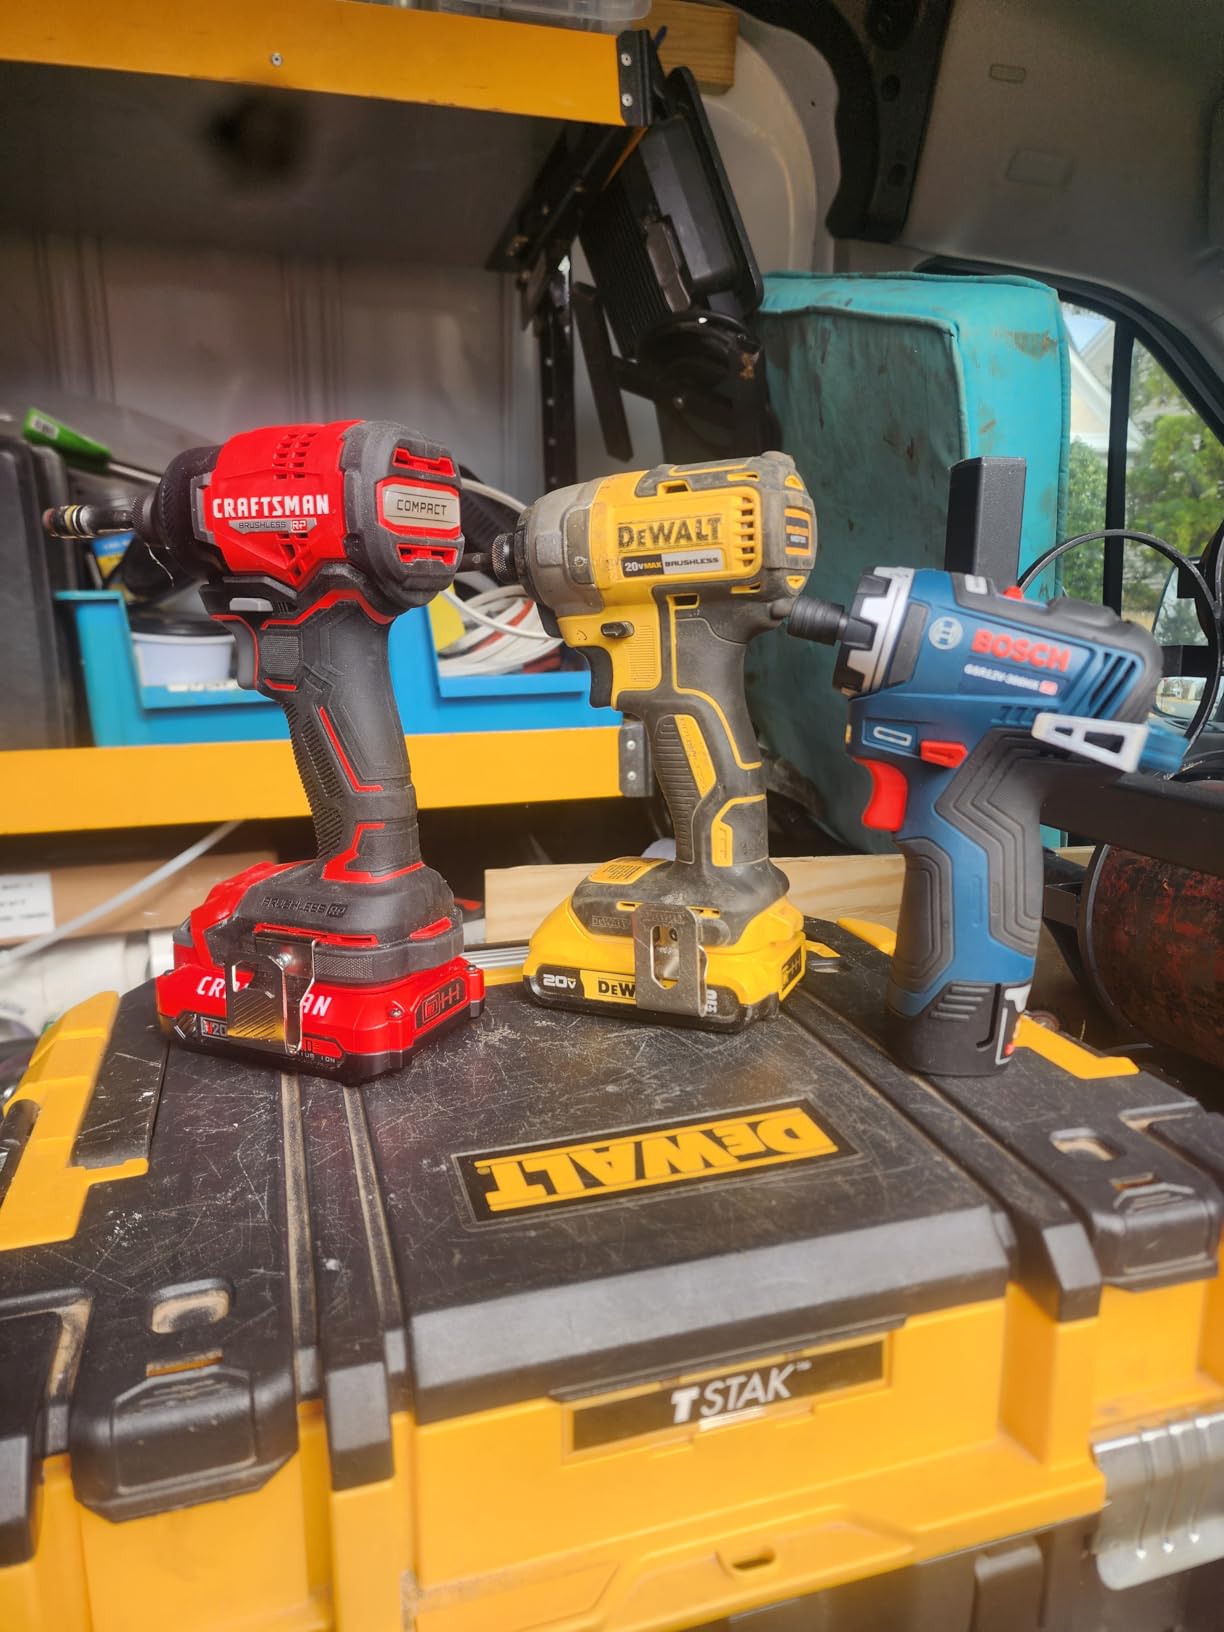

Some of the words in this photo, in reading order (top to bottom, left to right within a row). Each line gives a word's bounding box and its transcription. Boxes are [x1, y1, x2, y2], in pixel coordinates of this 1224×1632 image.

[212, 494, 329, 518] CRAFTSMAN
[396, 499, 447, 516] COMPACT
[239, 521, 286, 529] BRUSHLESS
[665, 557, 719, 567] BRUSHLESS
[971, 628, 1070, 673] BOSCH
[597, 980, 635, 999] DEW
